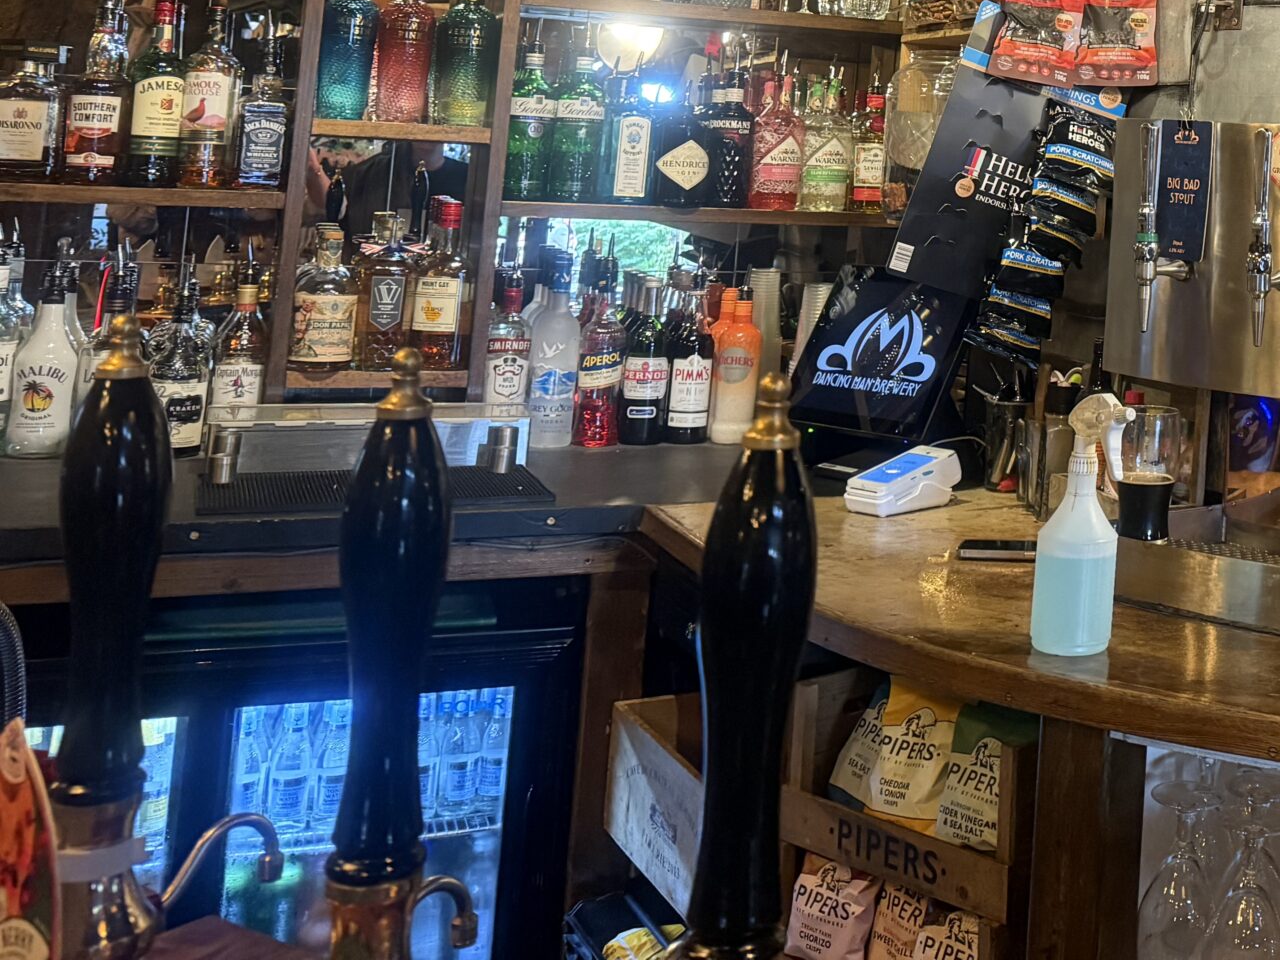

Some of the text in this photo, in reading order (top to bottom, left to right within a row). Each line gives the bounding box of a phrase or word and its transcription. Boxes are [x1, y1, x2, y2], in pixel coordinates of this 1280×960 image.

[73, 102, 117, 114] SOUTHERN
[74, 113, 114, 124] COMFORT
[1068, 133, 1105, 152] HEROES
[1050, 145, 1071, 156] PORK
[987, 153, 1025, 181] HEL
[1167, 177, 1200, 191] BIG BAD
[1169, 192, 1195, 205] STOUT
[1005, 250, 1024, 260] PORK
[313, 321, 331, 329] DON
[489, 341, 531, 350] SMIRNOFF
[582, 352, 620, 368] APEROL
[17, 365, 68, 383] MALIBU
[624, 370, 668, 380] PERNOD
[674, 366, 710, 381] PIMM'S
[812, 371, 922, 398] DANCING MAN BREWERY
[169, 405, 201, 413] KRAKEN
[855, 718, 883, 743] PIPE
[848, 757, 872, 776] SEA SALT
[879, 777, 911, 791] CHEDDAR
[884, 789, 906, 801] ONION
[883, 798, 899, 808] CRISPS
[939, 804, 998, 831] CIDER VINEGAR
[949, 817, 964, 832] SEA
[964, 824, 984, 839] SALT
[952, 831, 971, 843] CRISPS
[799, 930, 832, 949] CHORIZO
[873, 930, 893, 948] SWEET
[805, 943, 822, 955] CRISPS
